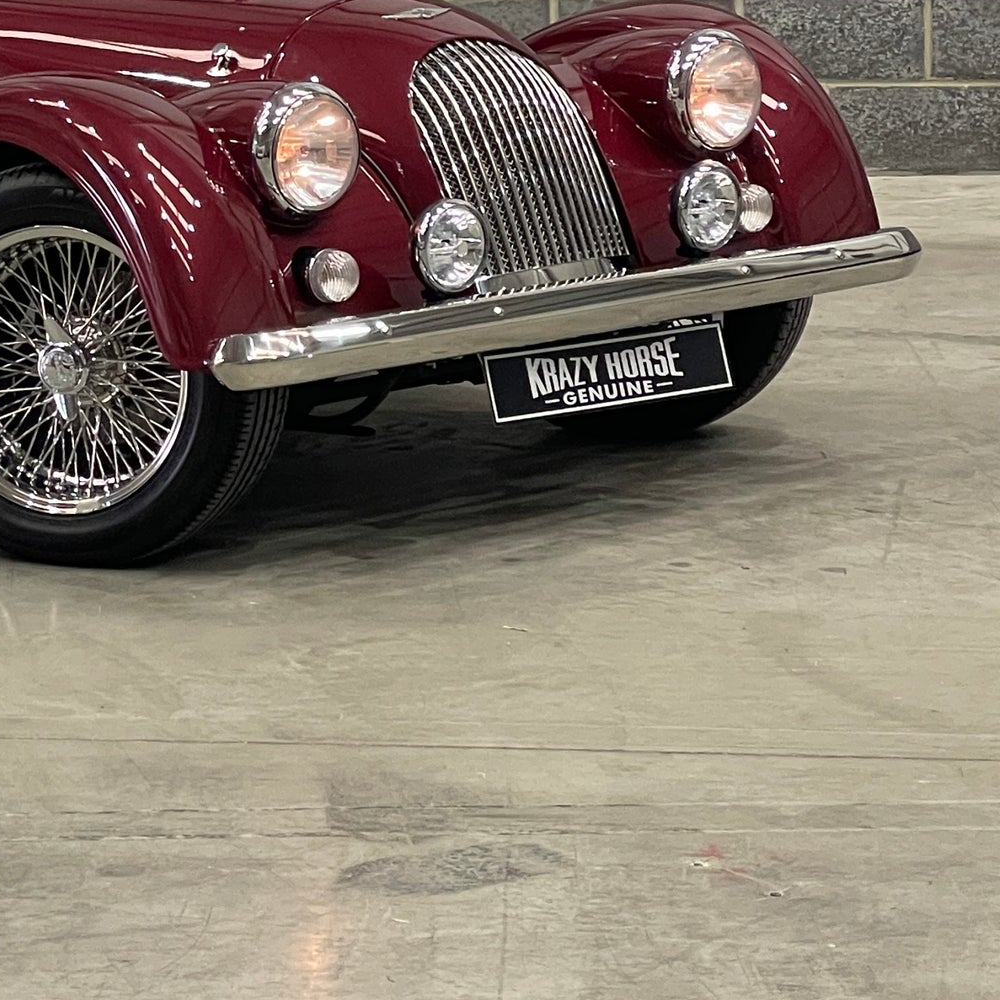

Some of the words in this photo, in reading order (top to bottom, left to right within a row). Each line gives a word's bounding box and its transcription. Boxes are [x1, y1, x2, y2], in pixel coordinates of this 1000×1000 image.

[524, 354, 599, 399] KRAZY
[604, 336, 684, 380] HORSE
[562, 380, 655, 406] GENUINE
